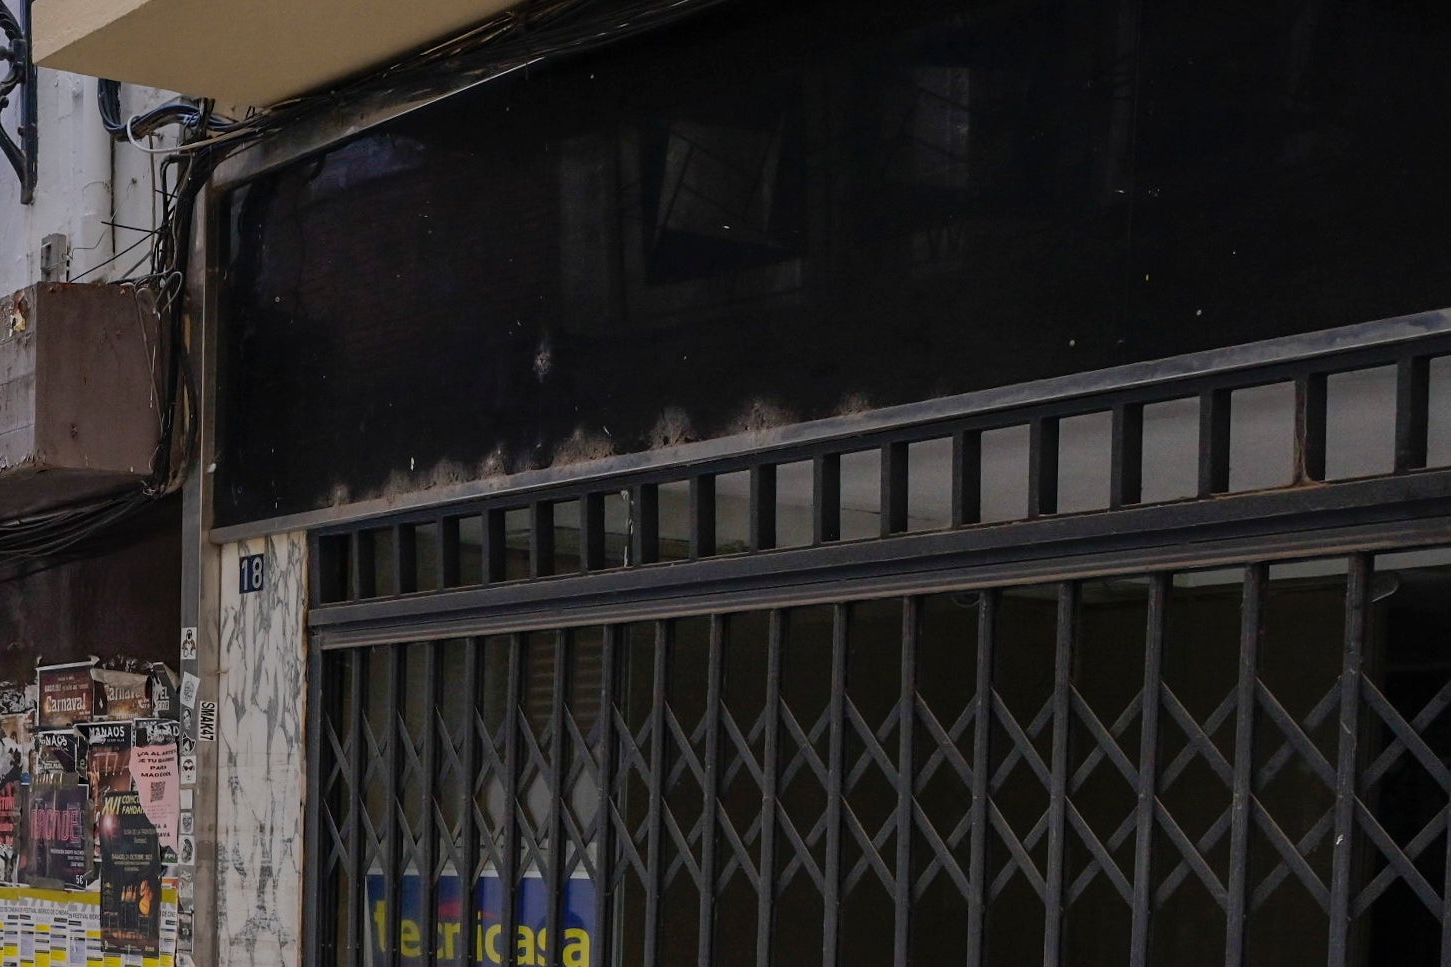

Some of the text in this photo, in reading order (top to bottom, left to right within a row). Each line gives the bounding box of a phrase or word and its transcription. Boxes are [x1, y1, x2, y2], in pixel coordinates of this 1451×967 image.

[241, 556, 263, 592] 18
[200, 701, 216, 741] SMAK47
[102, 795, 121, 816] XVI
[76, 874, 84, 885] 5€
